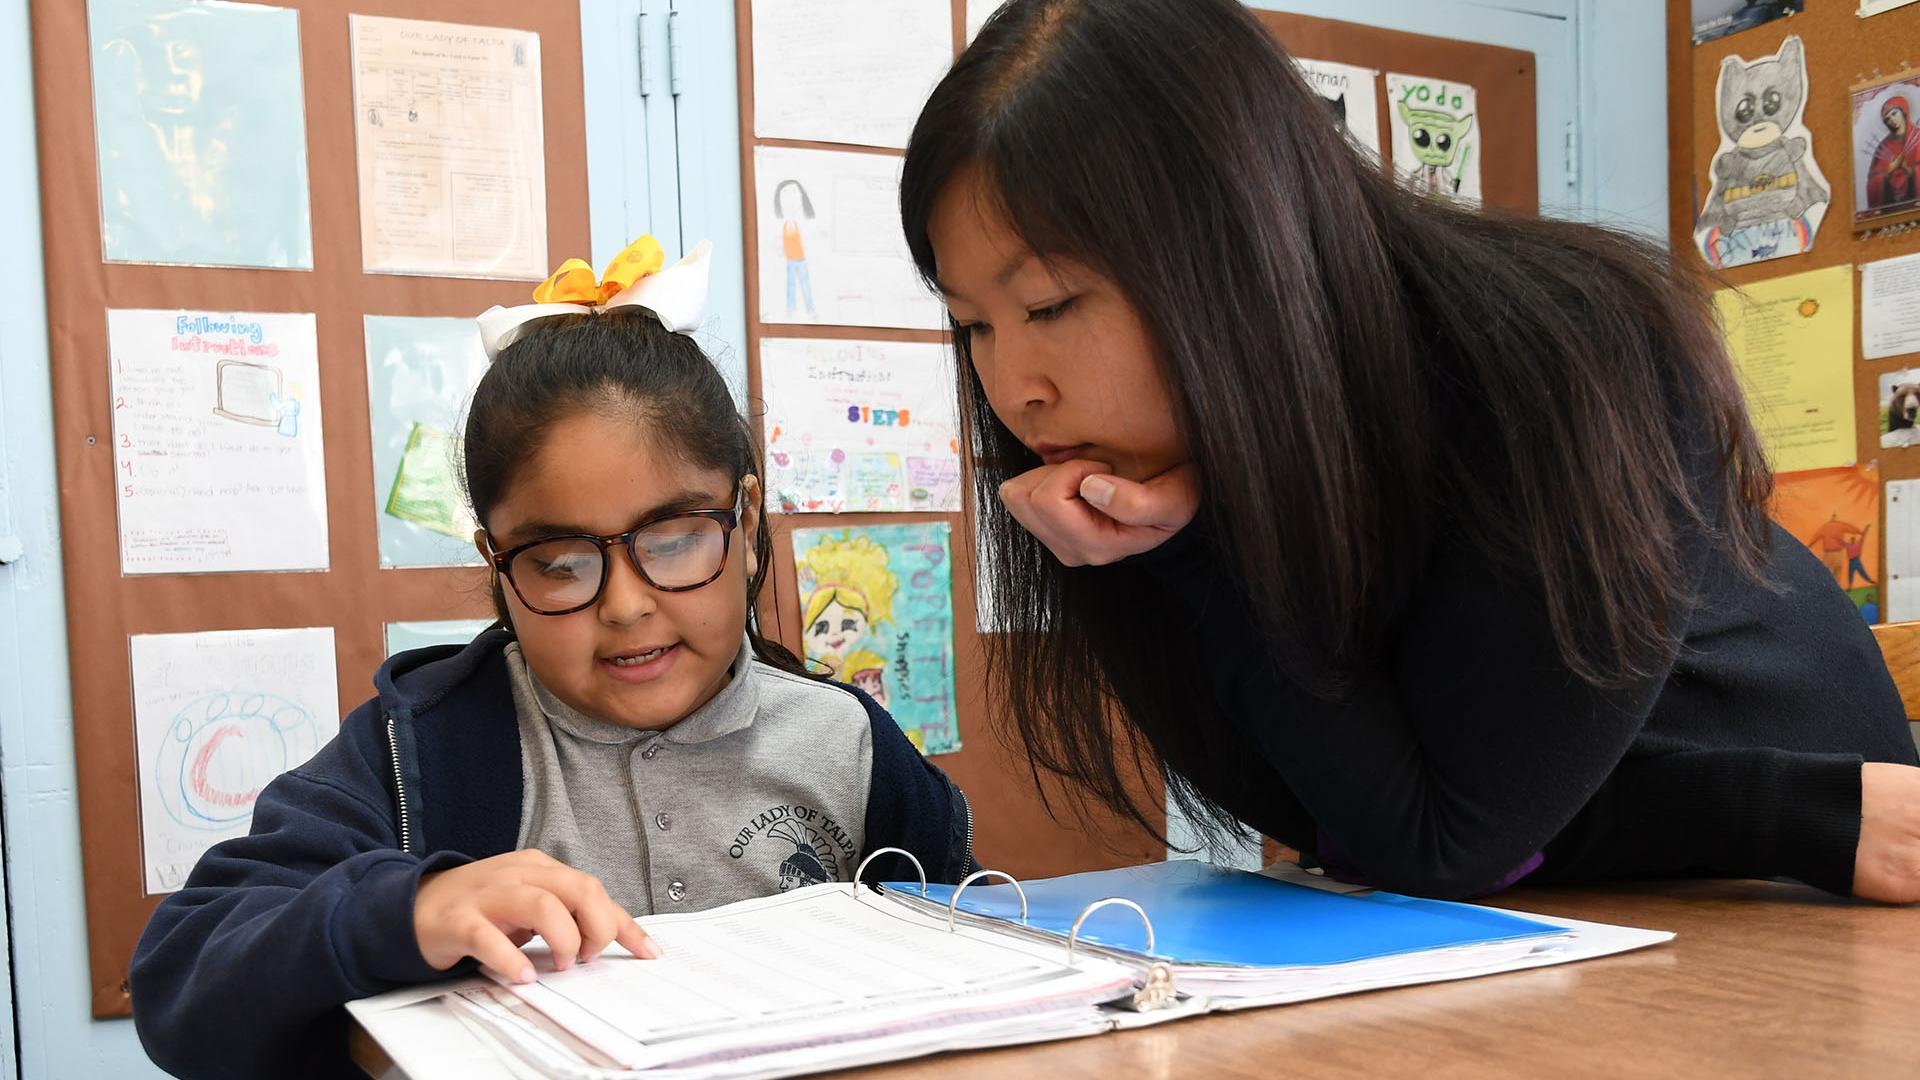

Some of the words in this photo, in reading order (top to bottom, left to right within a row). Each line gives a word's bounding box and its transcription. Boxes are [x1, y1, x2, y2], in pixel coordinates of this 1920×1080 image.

[1401, 84, 1463, 111] yoda
[176, 315, 263, 344] Following
[847, 405, 911, 428] STEPS
[729, 826, 758, 860] OUR
[751, 805, 791, 831] LADY
[794, 805, 818, 823] OF
[820, 815, 857, 861] TALPA
